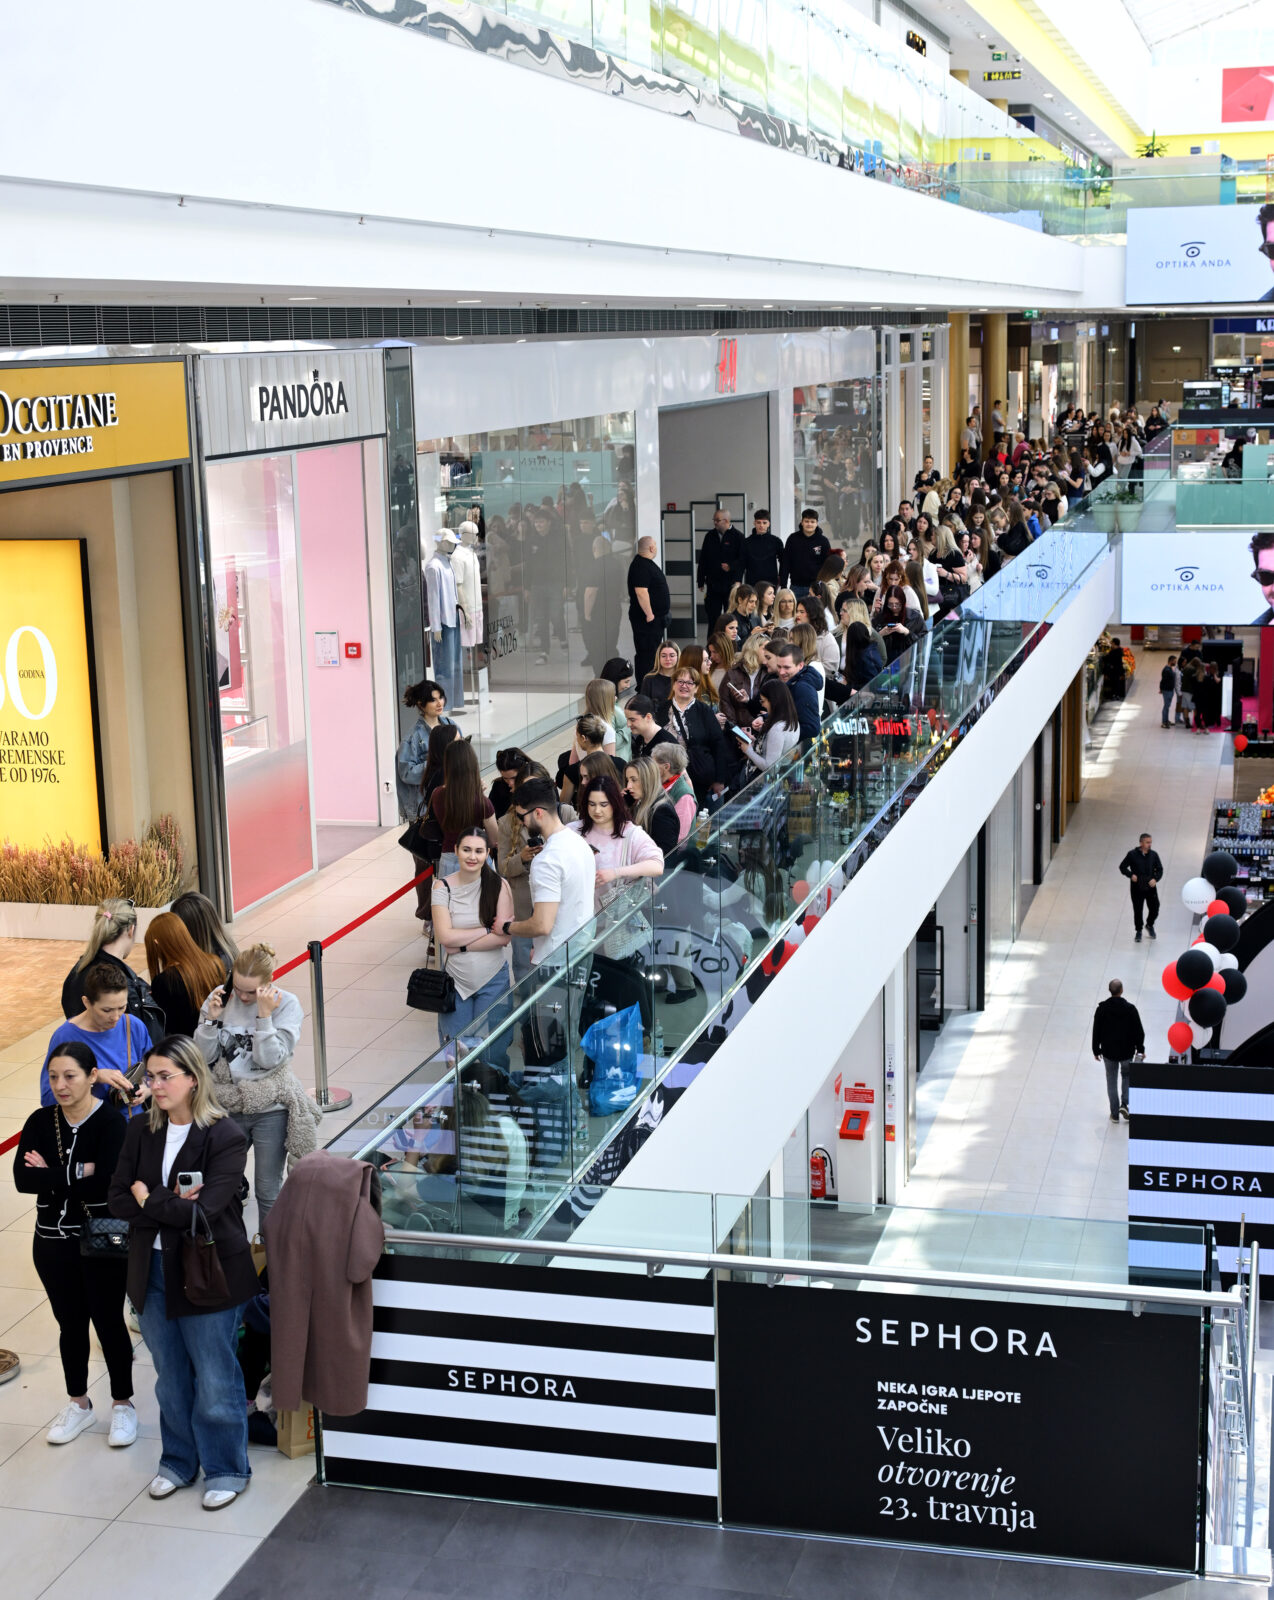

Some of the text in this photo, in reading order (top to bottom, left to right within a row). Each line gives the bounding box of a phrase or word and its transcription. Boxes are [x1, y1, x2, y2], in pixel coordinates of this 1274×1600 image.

[1155, 259, 1231, 269] OPTIKA ANDA
[258, 369, 349, 421] PANDORA
[2, 436, 94, 462] EN PROVENCE
[18, 669, 45, 679] GODINA
[10, 767, 28, 783] OD
[31, 767, 60, 784] 1976.
[1143, 1171, 1263, 1192] SEPHORA
[855, 1317, 1058, 1358] SEPHORA
[448, 1369, 577, 1398] SEPHORA
[877, 1381, 1021, 1404] NEKA IGRA LJEPOTE
[877, 1398, 948, 1415] ZAPOČNE
[876, 1425, 972, 1458] Veliko
[877, 1461, 1016, 1498] otvorenje
[879, 1496, 1037, 1533] 23. travnja
